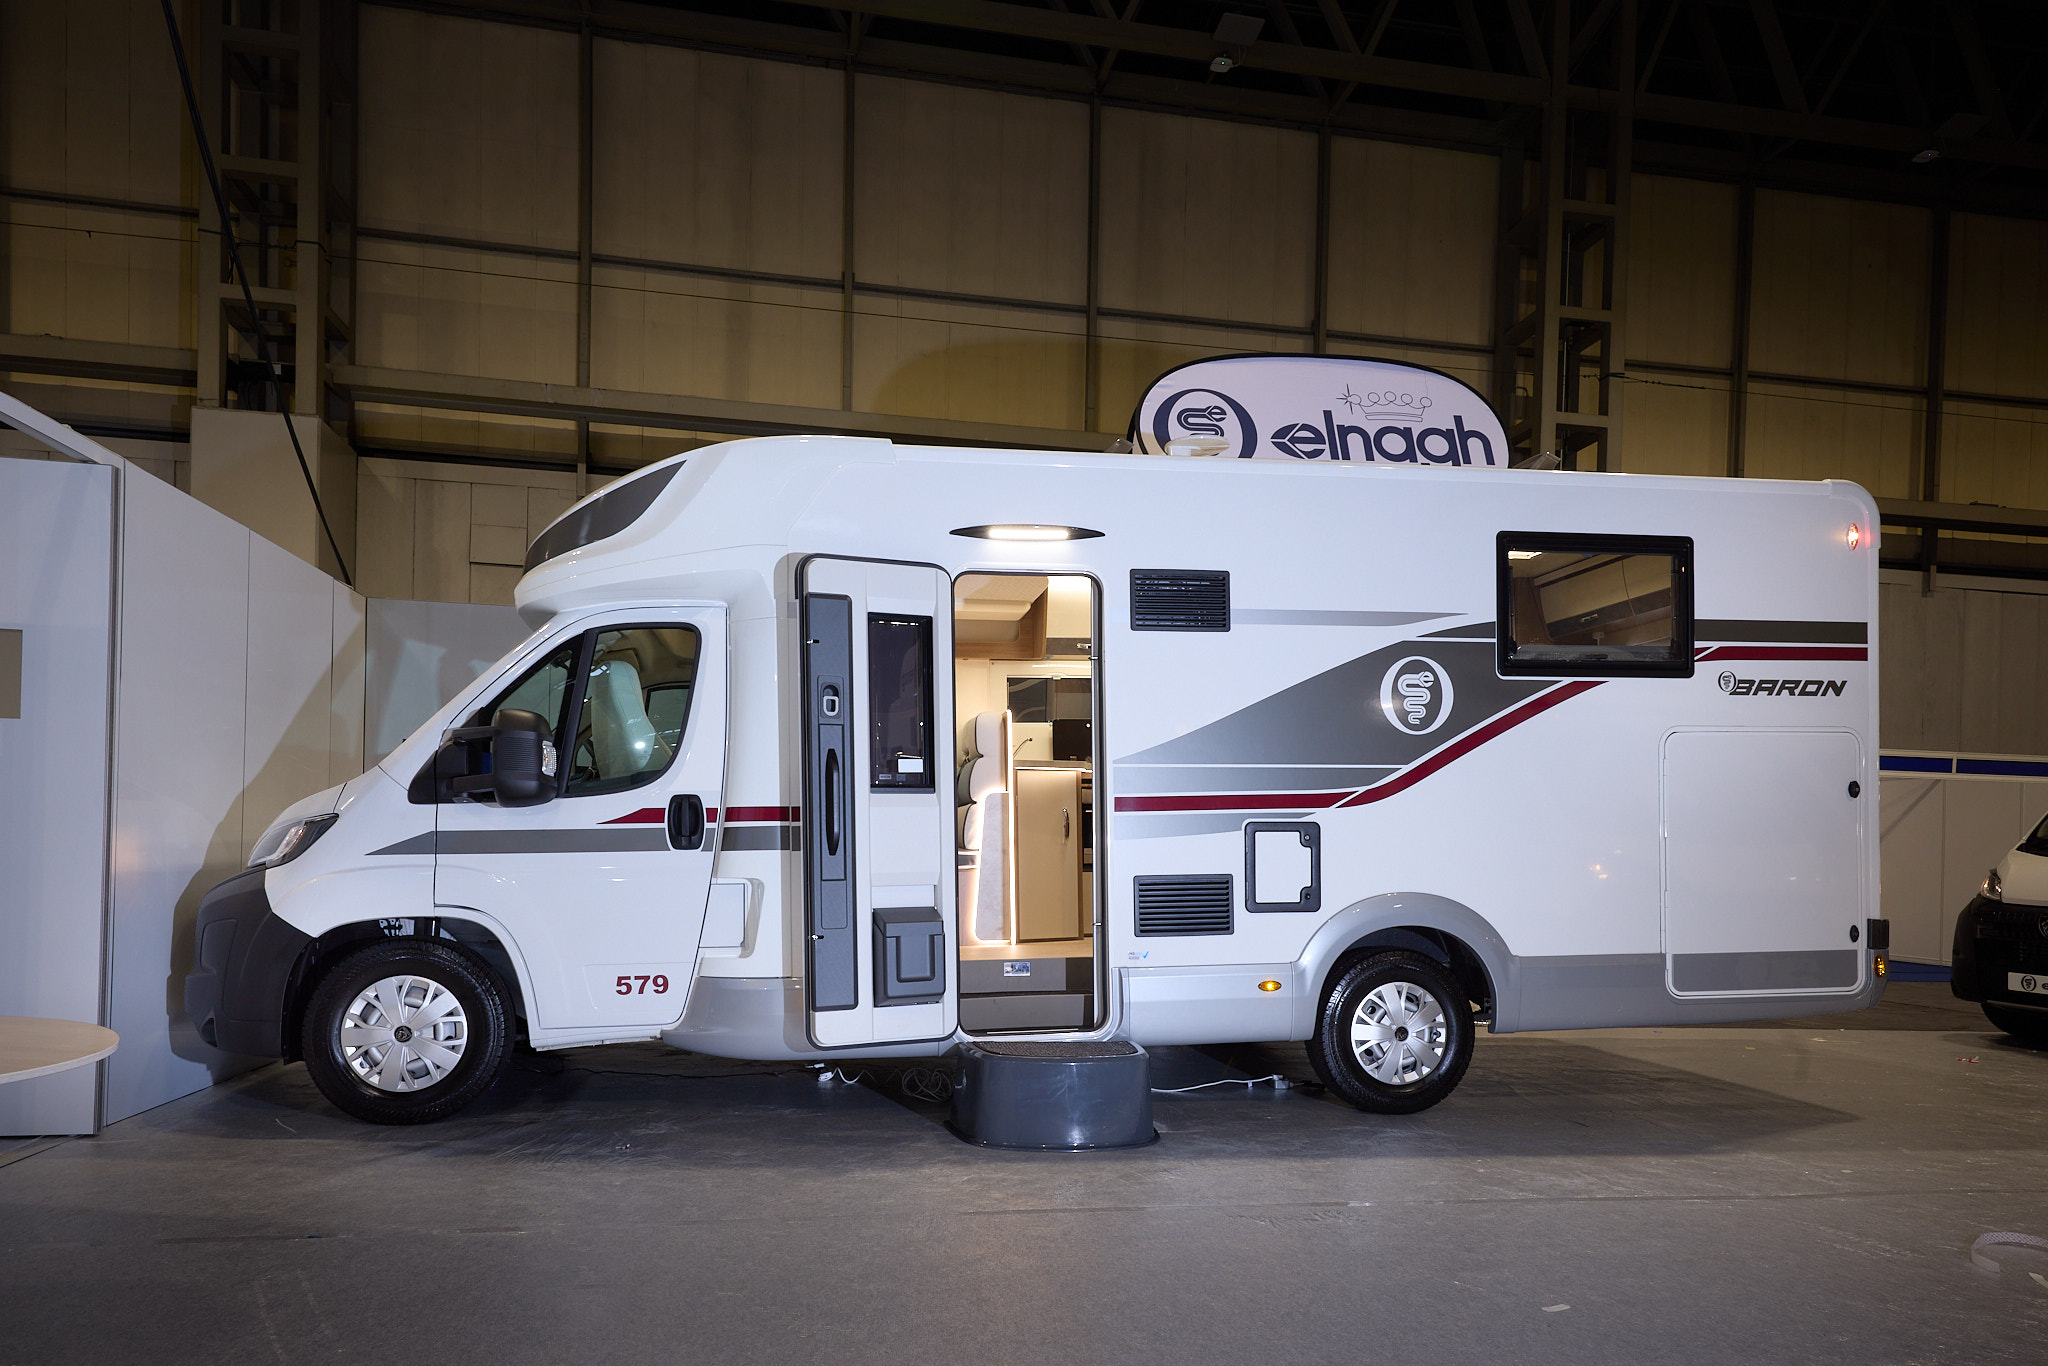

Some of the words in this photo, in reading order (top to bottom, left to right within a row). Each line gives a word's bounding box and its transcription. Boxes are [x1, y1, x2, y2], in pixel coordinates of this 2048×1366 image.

[1270, 410, 1496, 466] elnagh
[1729, 679, 1848, 697] BARON
[615, 974, 669, 996] 579
